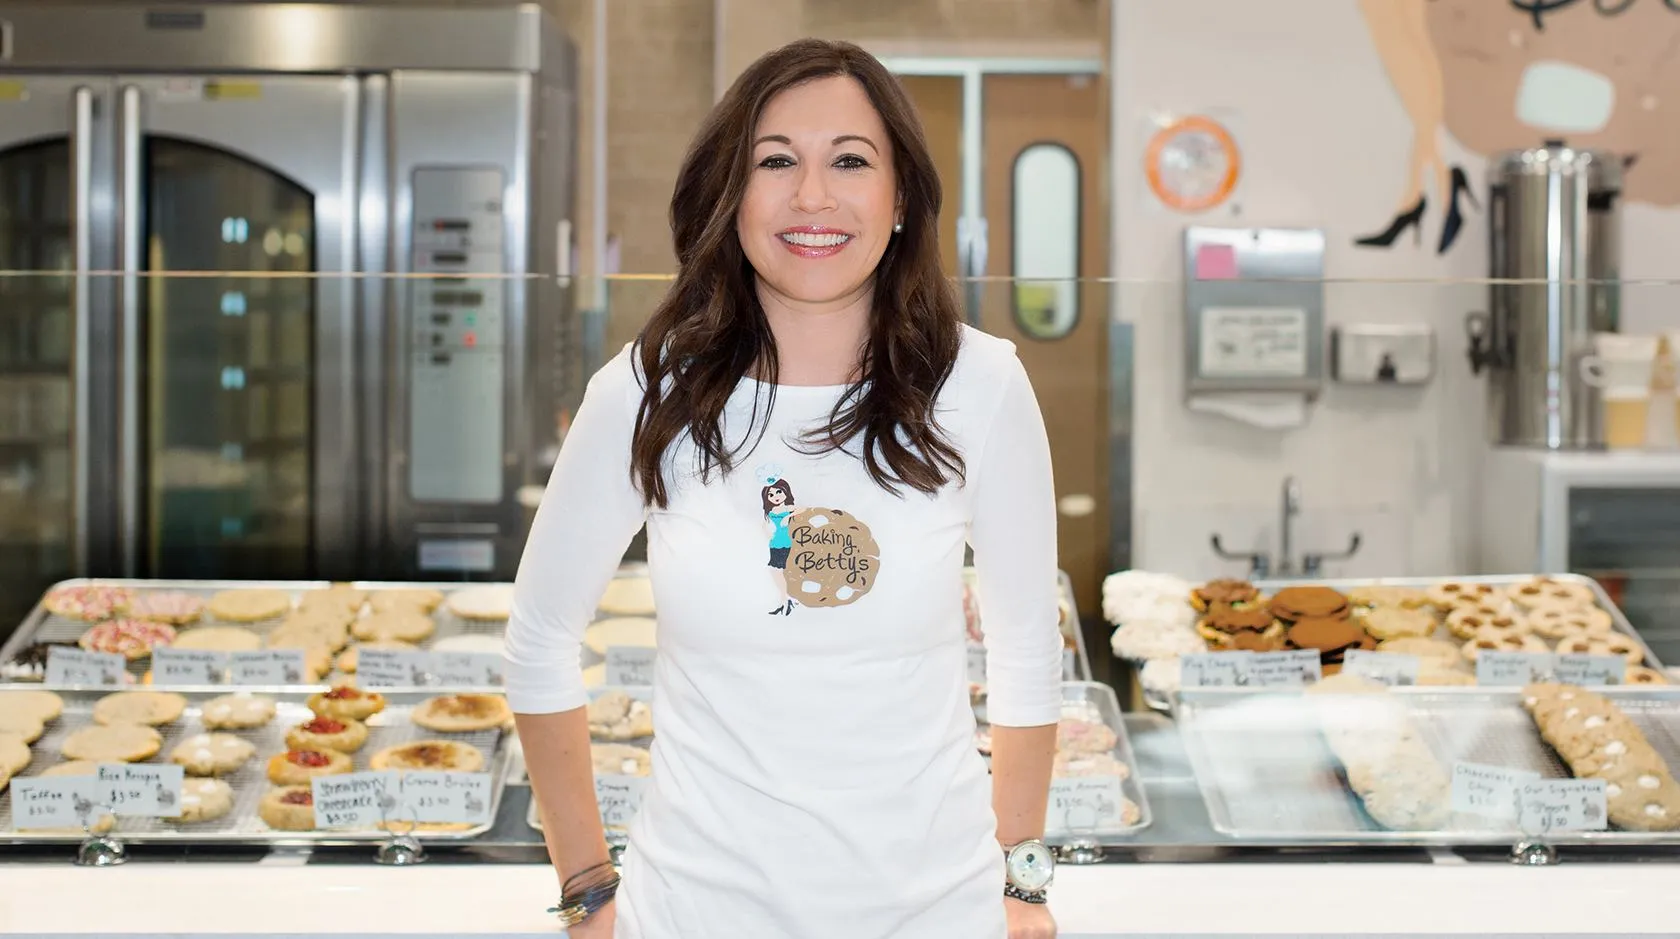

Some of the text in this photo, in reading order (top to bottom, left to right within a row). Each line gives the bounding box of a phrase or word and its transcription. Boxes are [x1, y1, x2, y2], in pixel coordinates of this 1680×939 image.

[792, 526, 857, 556] Baking
[20, 787, 64, 801] Toffee
[1524, 783, 1602, 800] Our Signature
